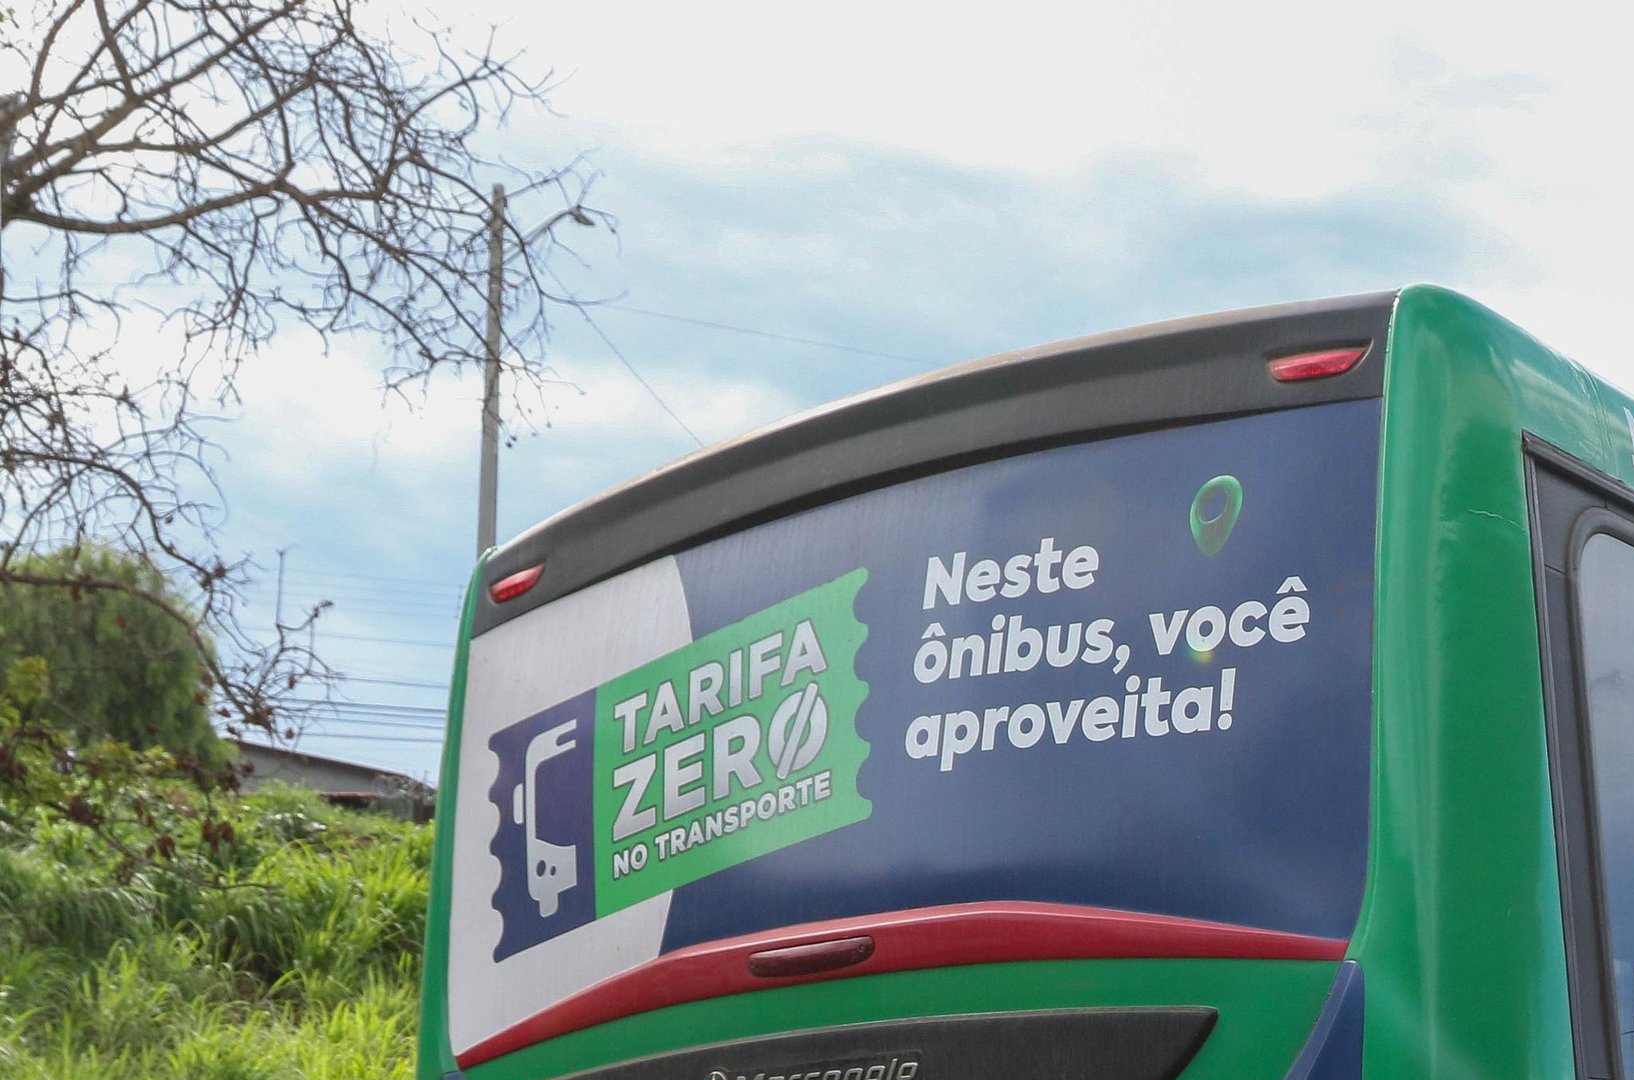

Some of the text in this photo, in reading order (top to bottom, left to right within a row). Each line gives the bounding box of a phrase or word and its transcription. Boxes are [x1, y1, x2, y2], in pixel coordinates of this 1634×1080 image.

[921, 538, 1100, 610] Neste
[912, 577, 1311, 685] ônibus, você
[614, 619, 828, 753] TARIFA
[904, 667, 1235, 772] aproveita!
[613, 770, 831, 879] NO TRANSPORTE
